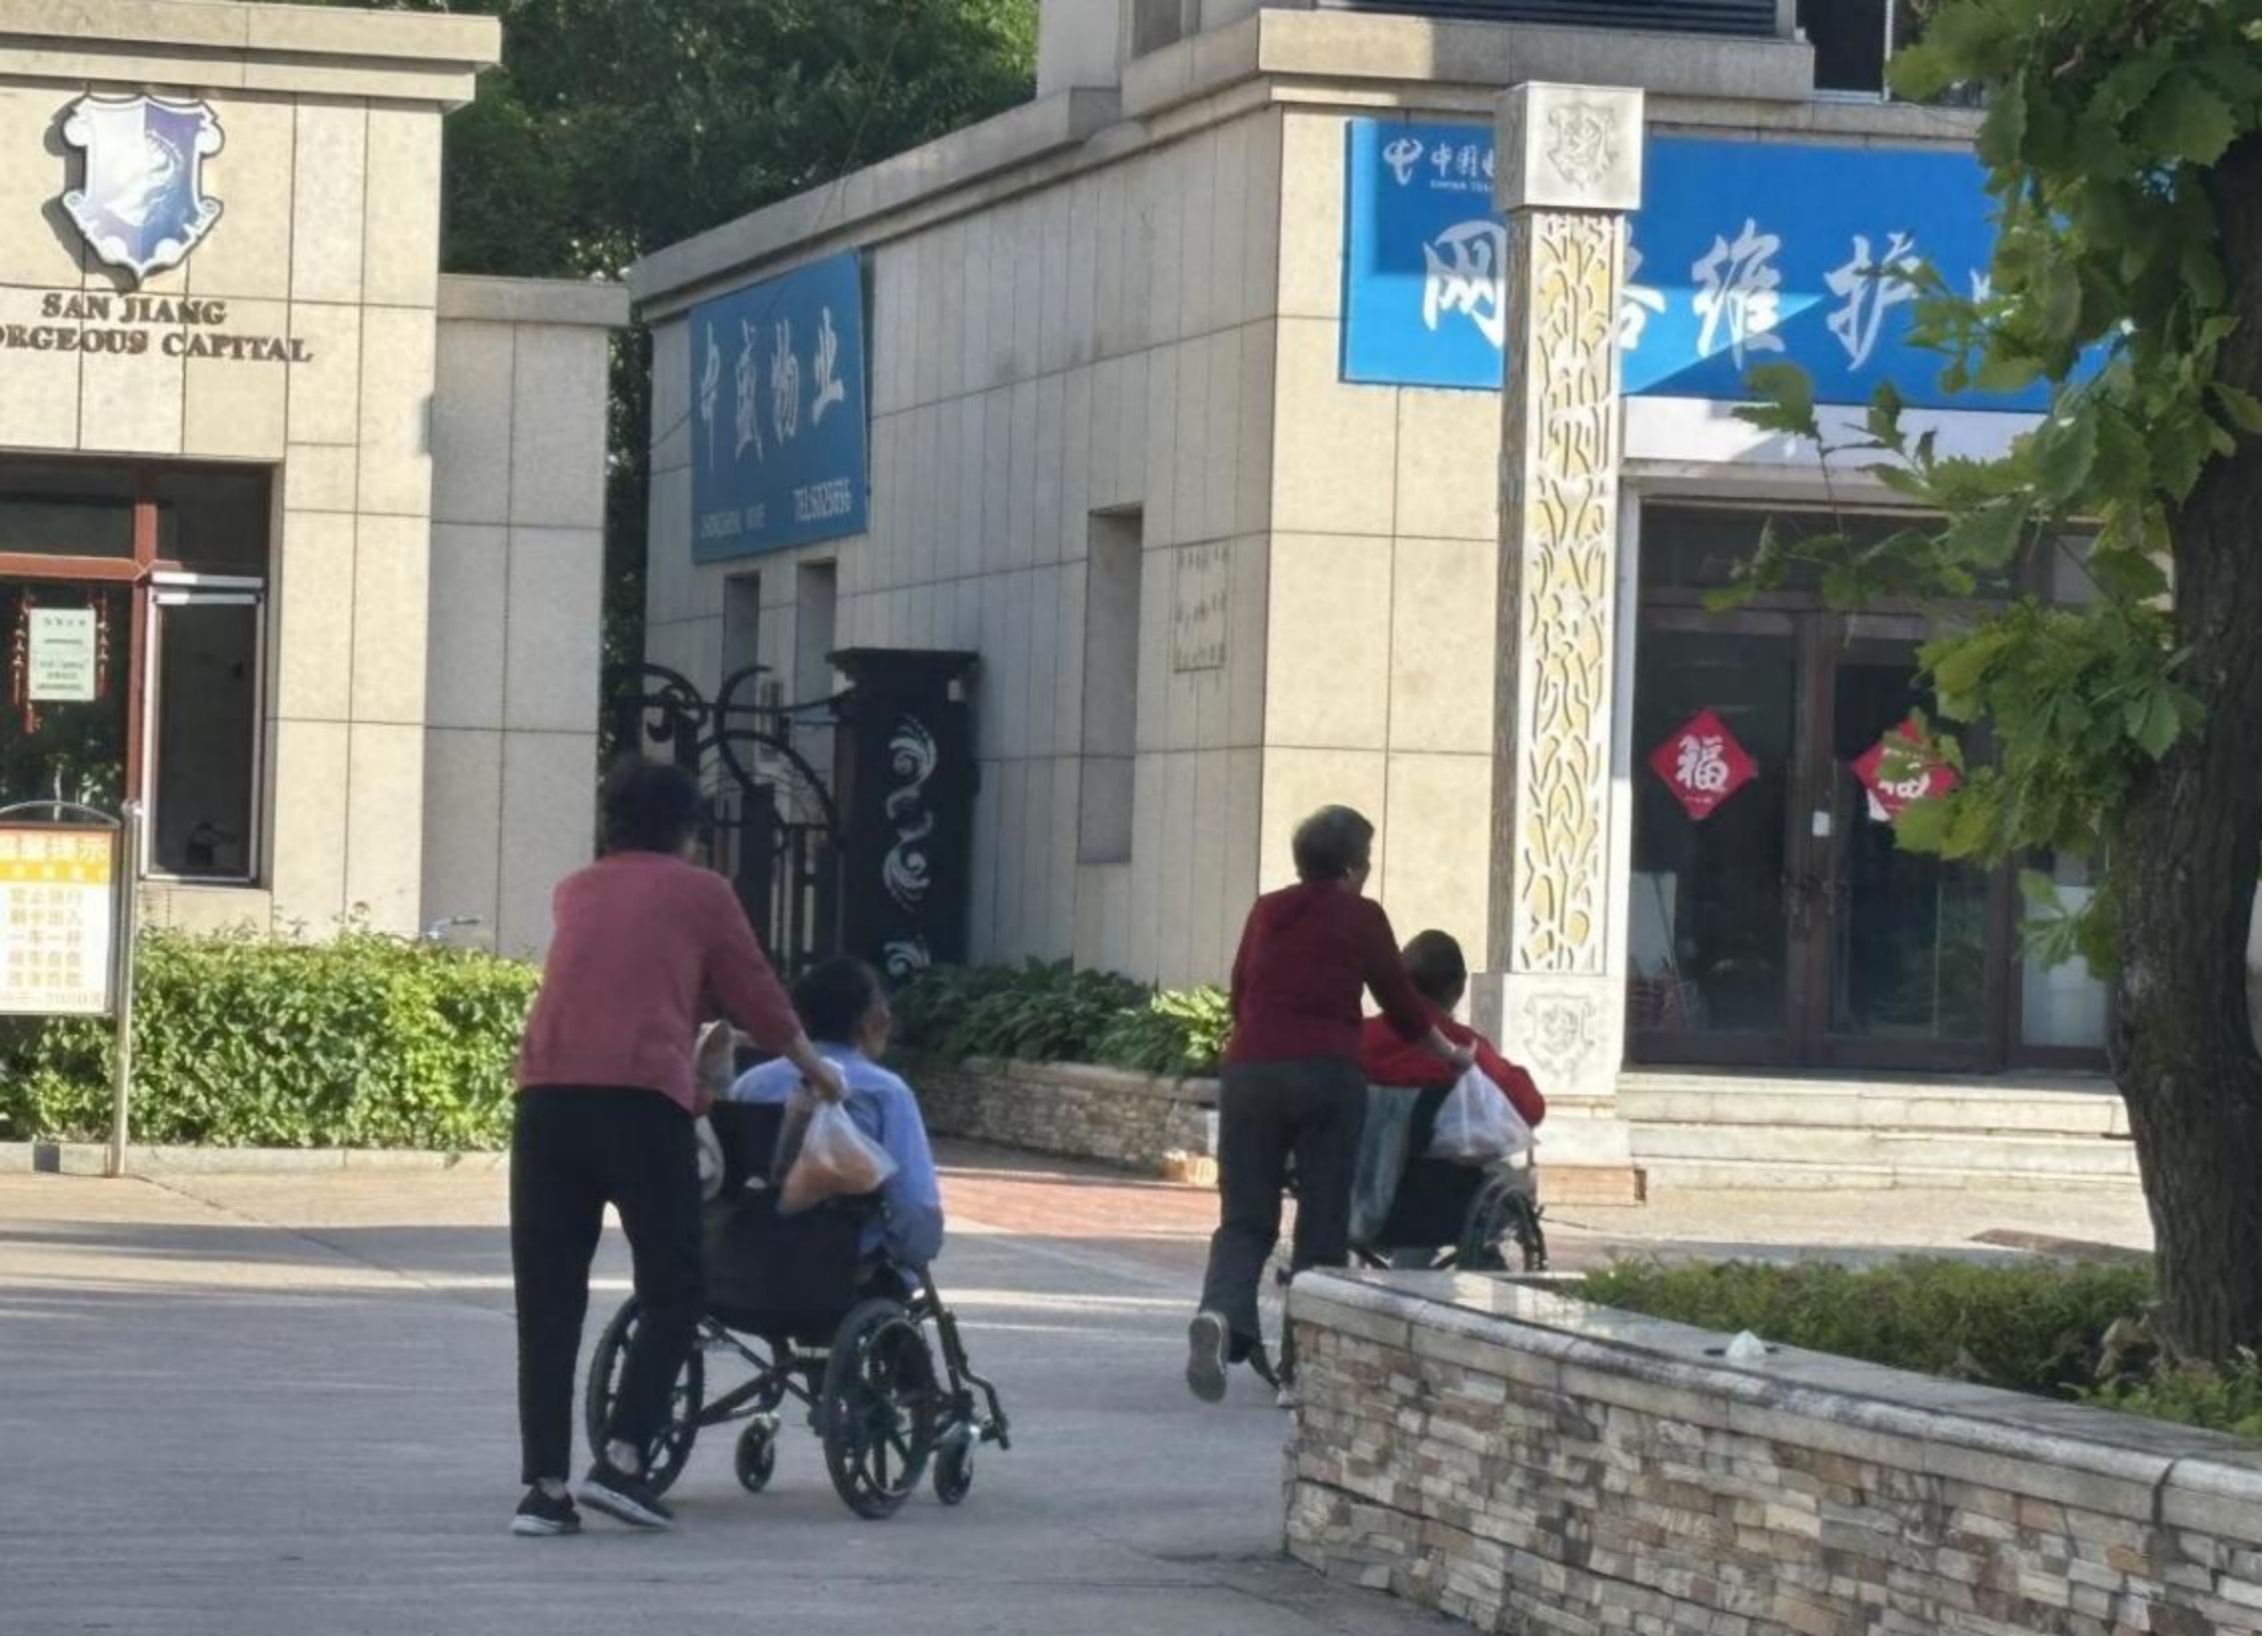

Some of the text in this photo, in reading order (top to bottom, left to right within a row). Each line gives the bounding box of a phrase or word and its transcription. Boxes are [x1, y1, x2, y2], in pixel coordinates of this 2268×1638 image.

[41, 292, 227, 325] SAN JIANG
[161, 332, 314, 362] CAPITAL
[1676, 734, 1728, 792] 福
